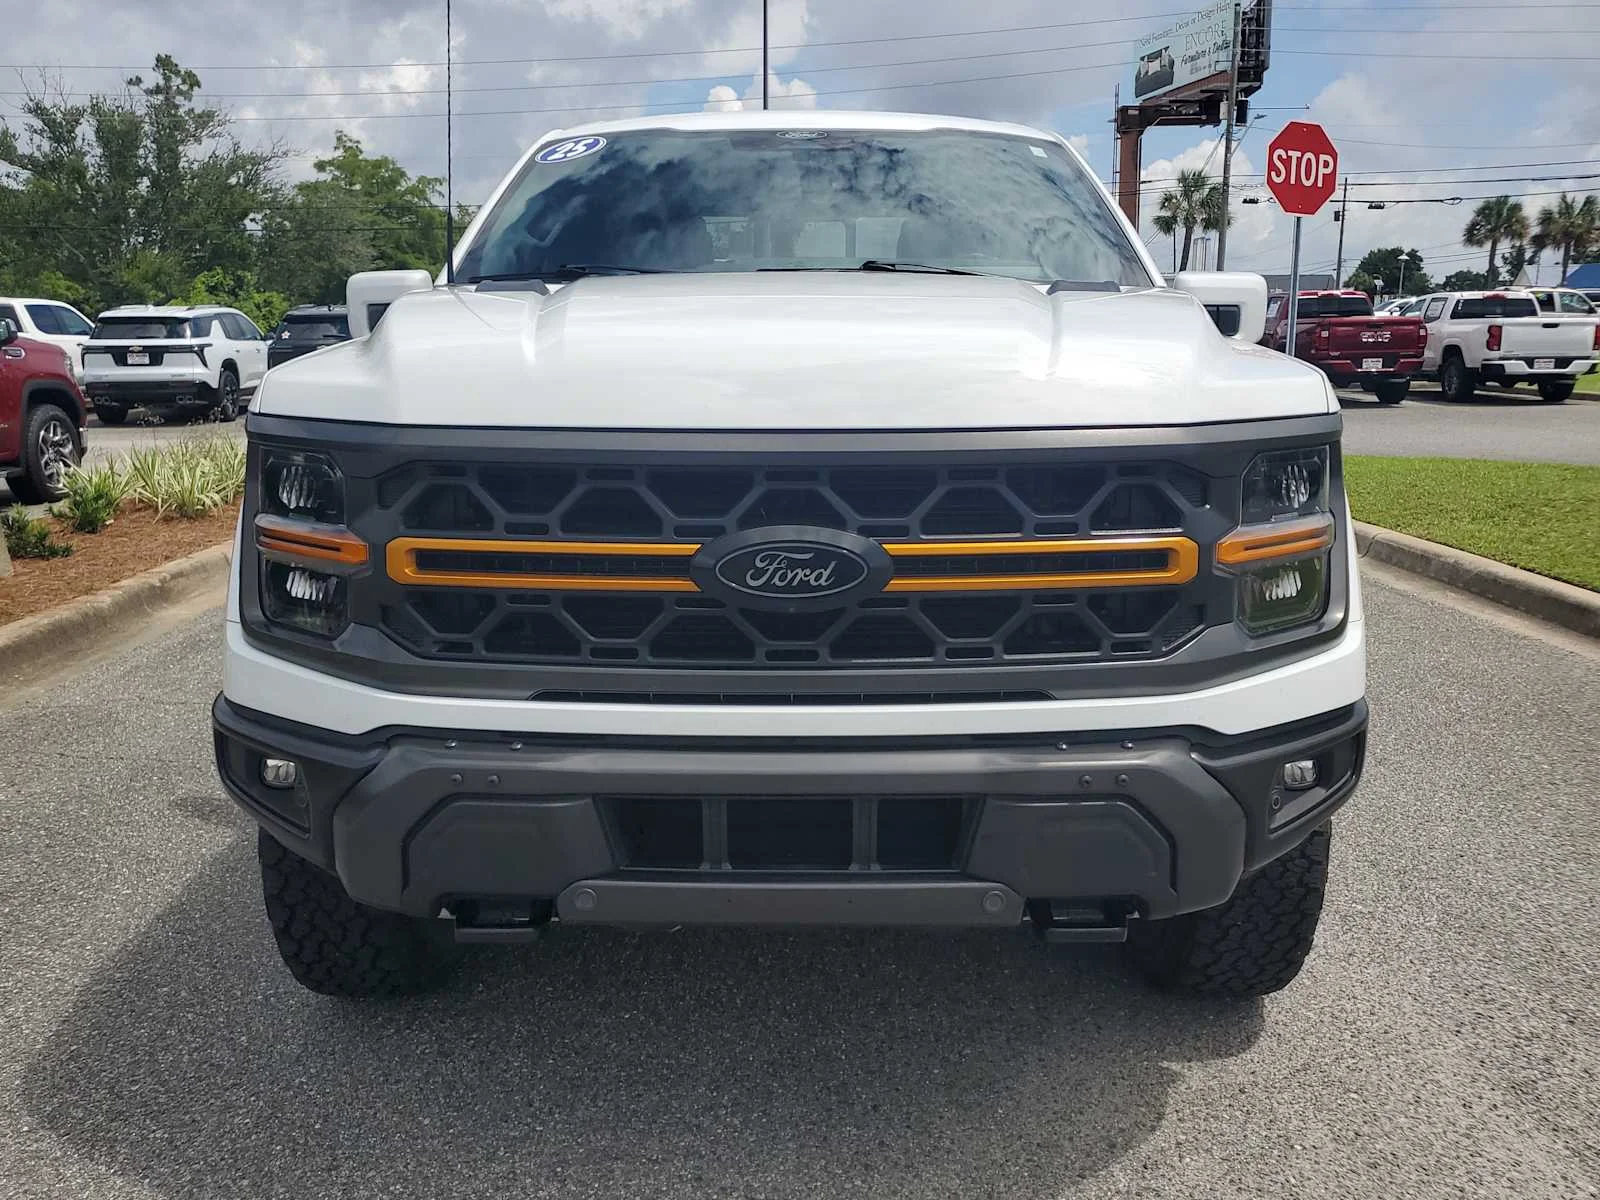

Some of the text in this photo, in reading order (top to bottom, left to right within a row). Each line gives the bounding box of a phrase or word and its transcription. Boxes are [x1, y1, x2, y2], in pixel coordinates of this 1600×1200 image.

[546, 139, 595, 160] 25
[1270, 148, 1334, 188] STOP
[745, 551, 838, 587] Ford
